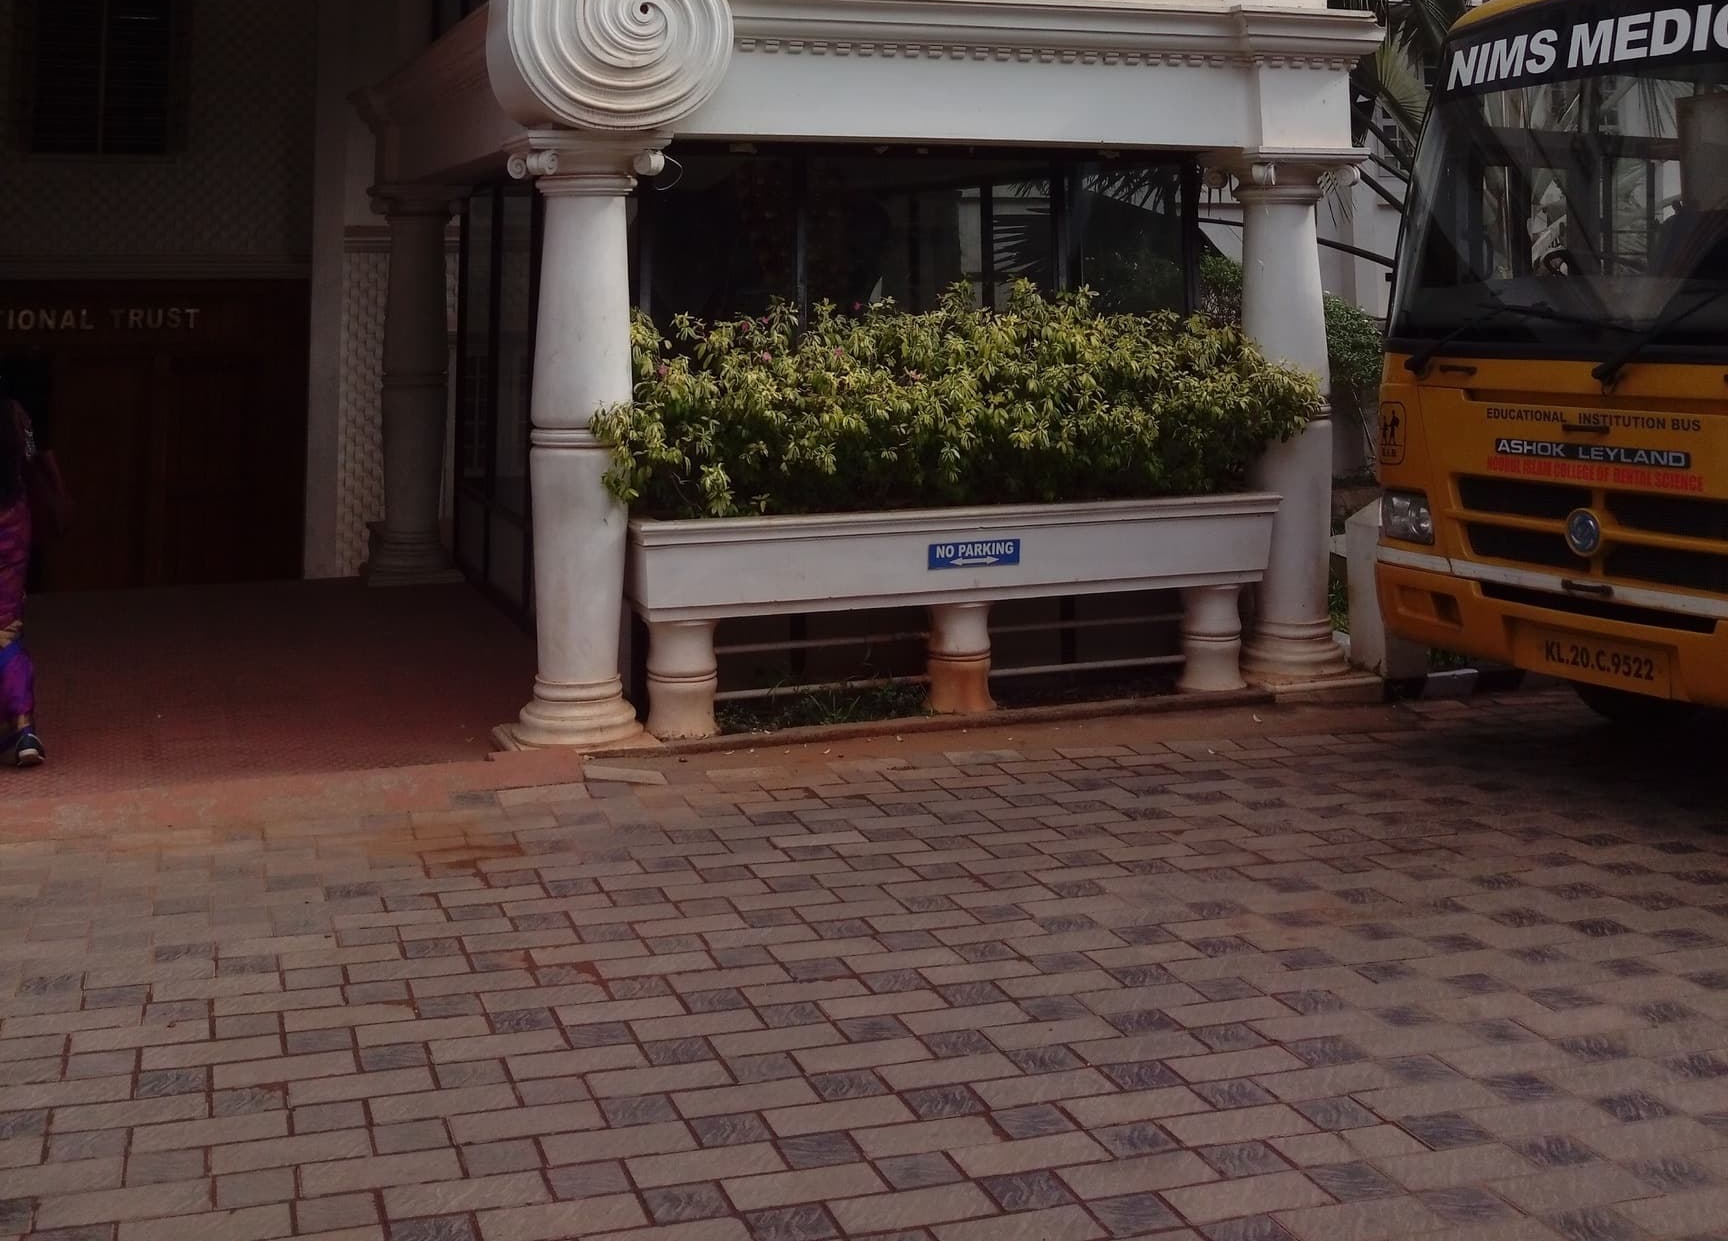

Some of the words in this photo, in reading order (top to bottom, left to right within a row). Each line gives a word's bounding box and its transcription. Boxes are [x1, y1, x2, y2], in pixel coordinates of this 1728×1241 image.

[1446, 28, 1559, 92] NIMS
[110, 307, 200, 329] TRUST
[1486, 407, 1567, 424] EDUCATIONAL
[1578, 412, 1666, 431] INSTITUTION
[1671, 418, 1701, 432] BUS
[1496, 439, 1567, 458] ASHOK
[1578, 445, 1687, 468] LEYLAND
[936, 545, 954, 559] NO
[958, 541, 1014, 557] PARKING
